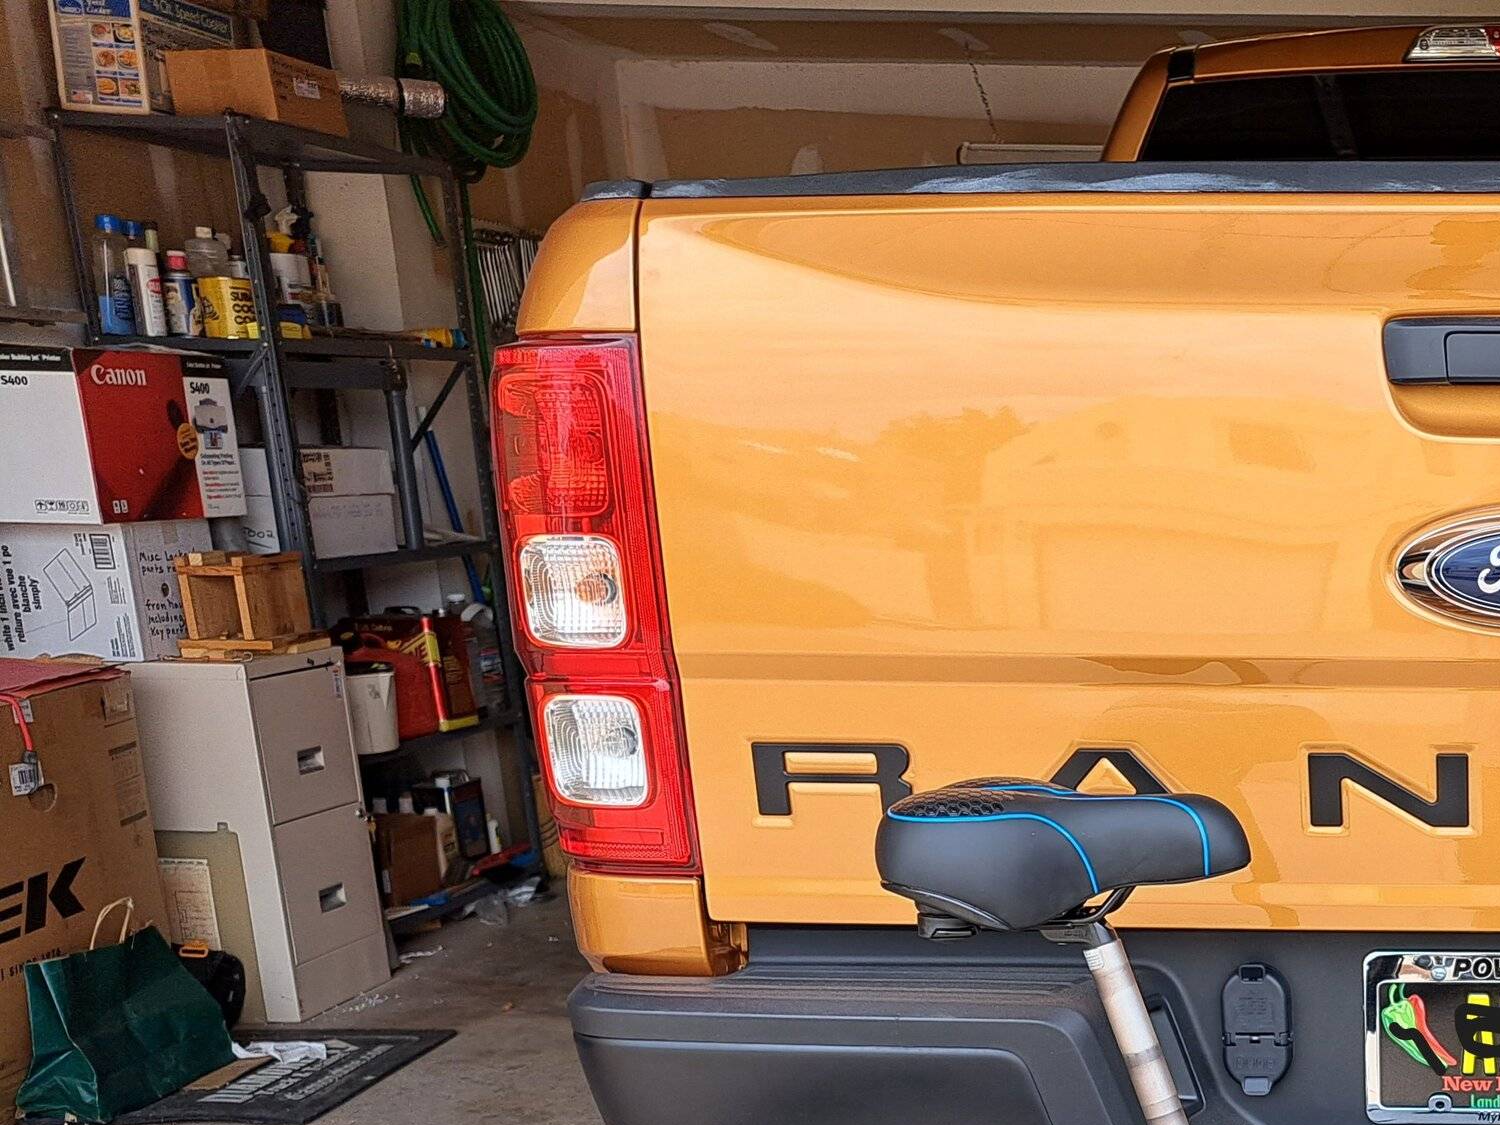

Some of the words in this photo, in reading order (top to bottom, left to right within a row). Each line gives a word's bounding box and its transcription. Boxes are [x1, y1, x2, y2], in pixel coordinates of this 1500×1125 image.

[0, 375, 28, 386] S400
[91, 364, 147, 386] Canon
[190, 382, 210, 394] S400
[8, 568, 16, 585] vue
[11, 588, 20, 611] avec
[18, 575, 31, 613] blanche
[28, 577, 41, 611] simply
[2, 627, 15, 651] white
[1442, 1077, 1483, 1092] New
[1471, 1094, 1500, 1108] Land
